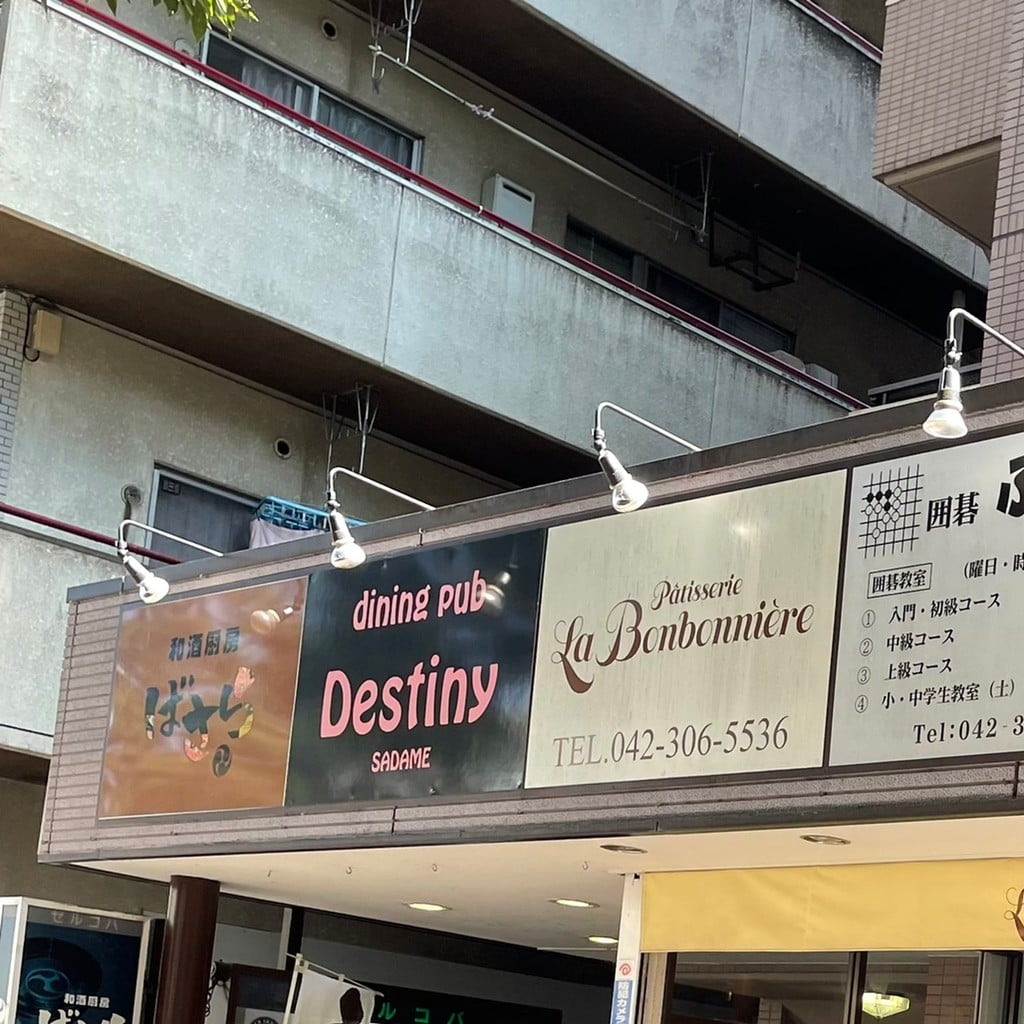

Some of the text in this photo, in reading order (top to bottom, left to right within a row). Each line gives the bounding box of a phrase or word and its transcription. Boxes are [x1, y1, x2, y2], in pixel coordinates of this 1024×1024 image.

[925, 491, 981, 532] 囲碁
[650, 573, 743, 610] Pâtisserie
[871, 568, 928, 594] 囲碁教室
[353, 570, 487, 632] dining pub
[888, 592, 1001, 625] 入門・初級コース
[168, 626, 240, 662] 和酒厨房
[551, 593, 815, 694] La Bonbonnière
[886, 629, 955, 652] 中級コース
[884, 657, 953, 681] 上級コース
[320, 654, 499, 738] Destiny
[371, 746, 431, 774] SADAME
